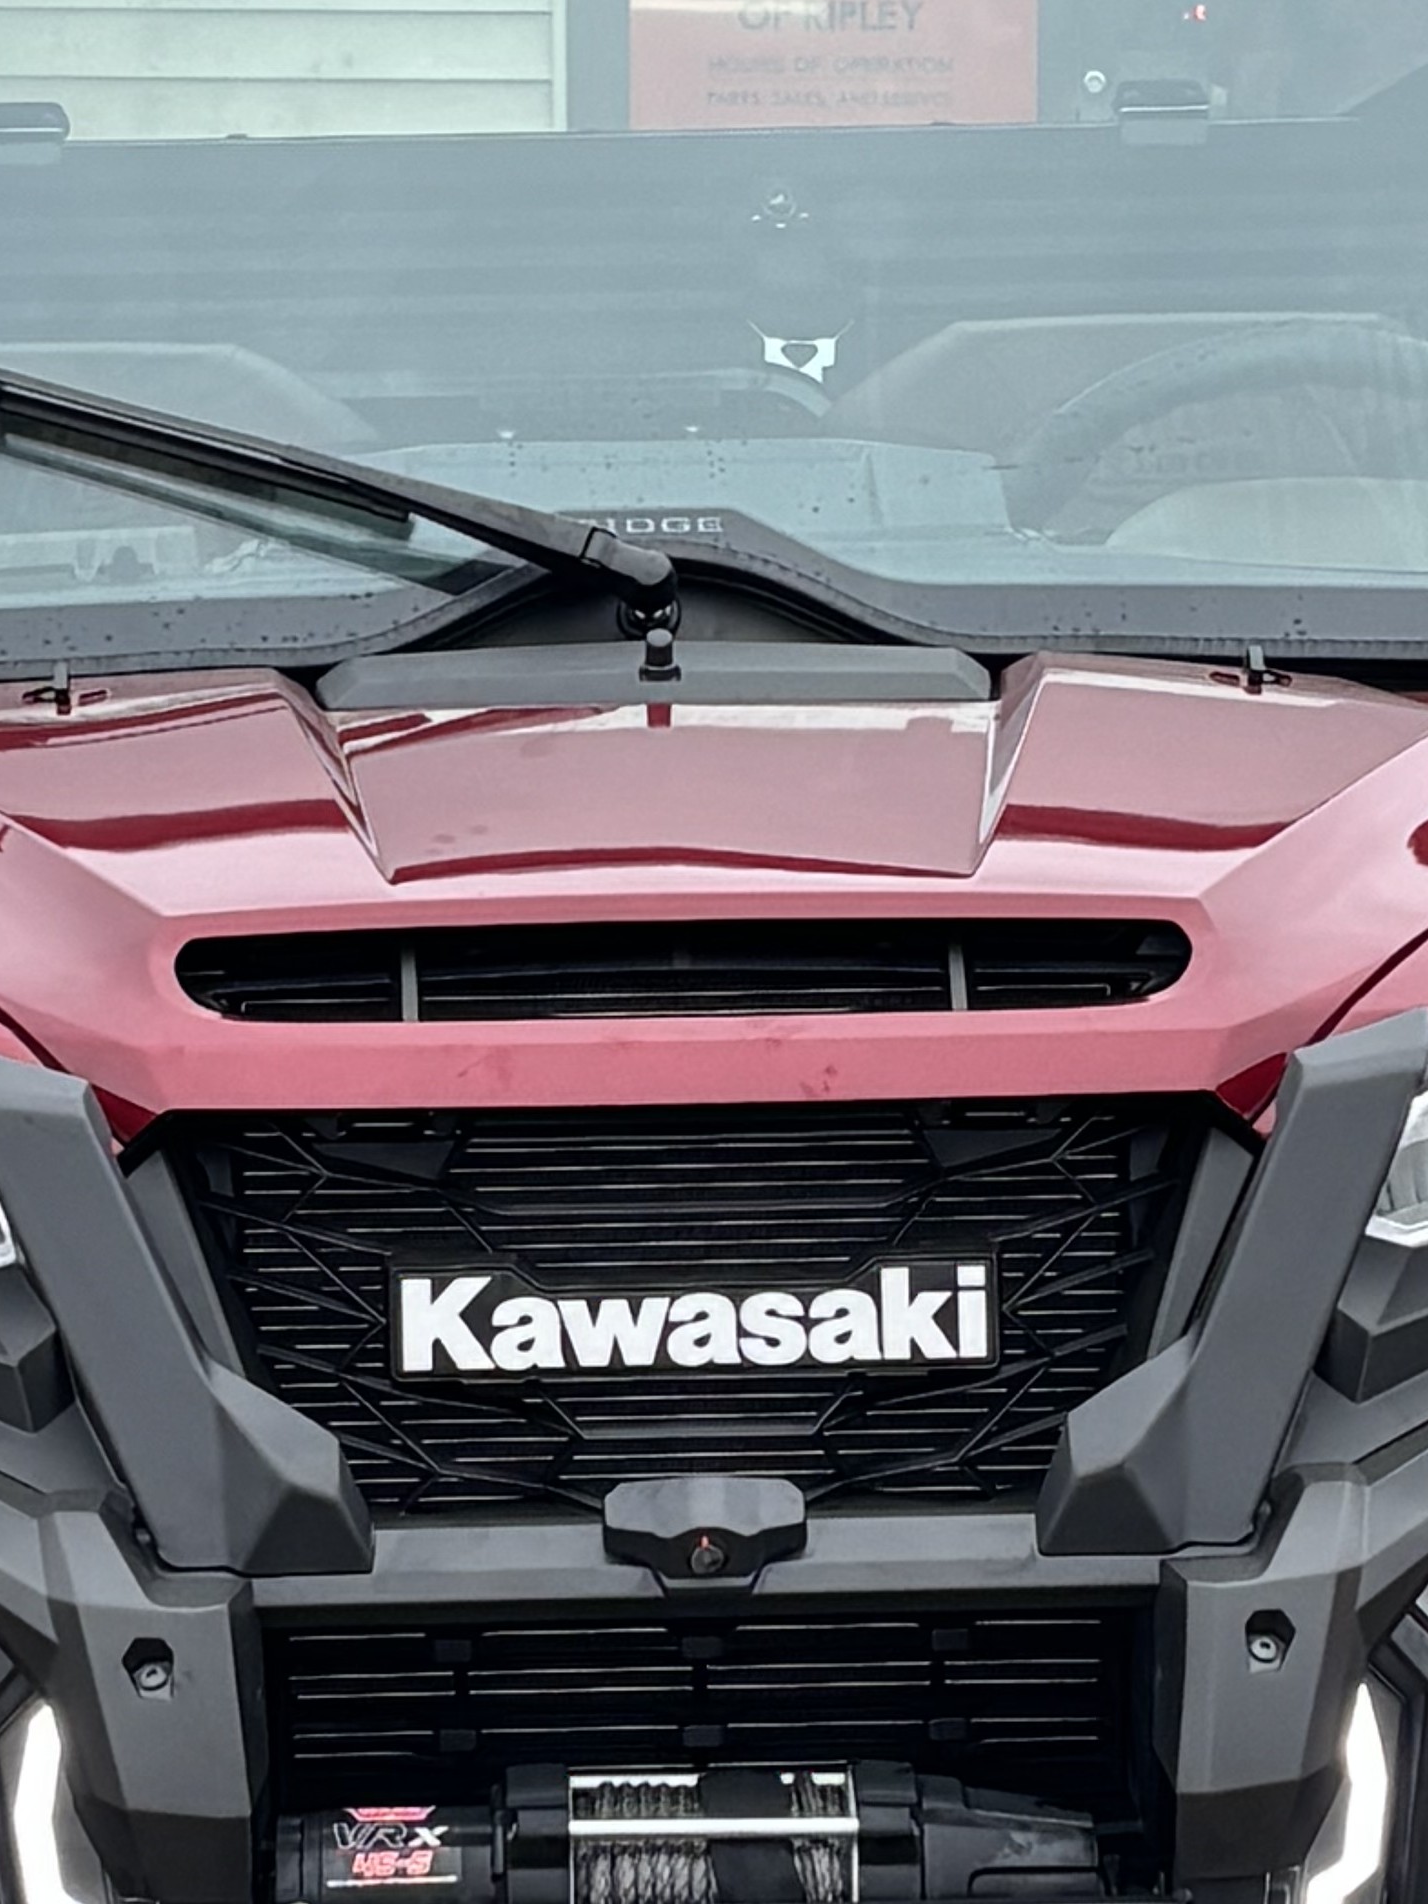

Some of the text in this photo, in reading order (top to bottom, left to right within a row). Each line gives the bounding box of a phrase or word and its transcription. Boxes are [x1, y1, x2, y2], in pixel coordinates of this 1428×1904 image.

[577, 516, 723, 534] IDGE
[400, 1265, 988, 1373] Kawasaki
[332, 1821, 449, 1851] VRX
